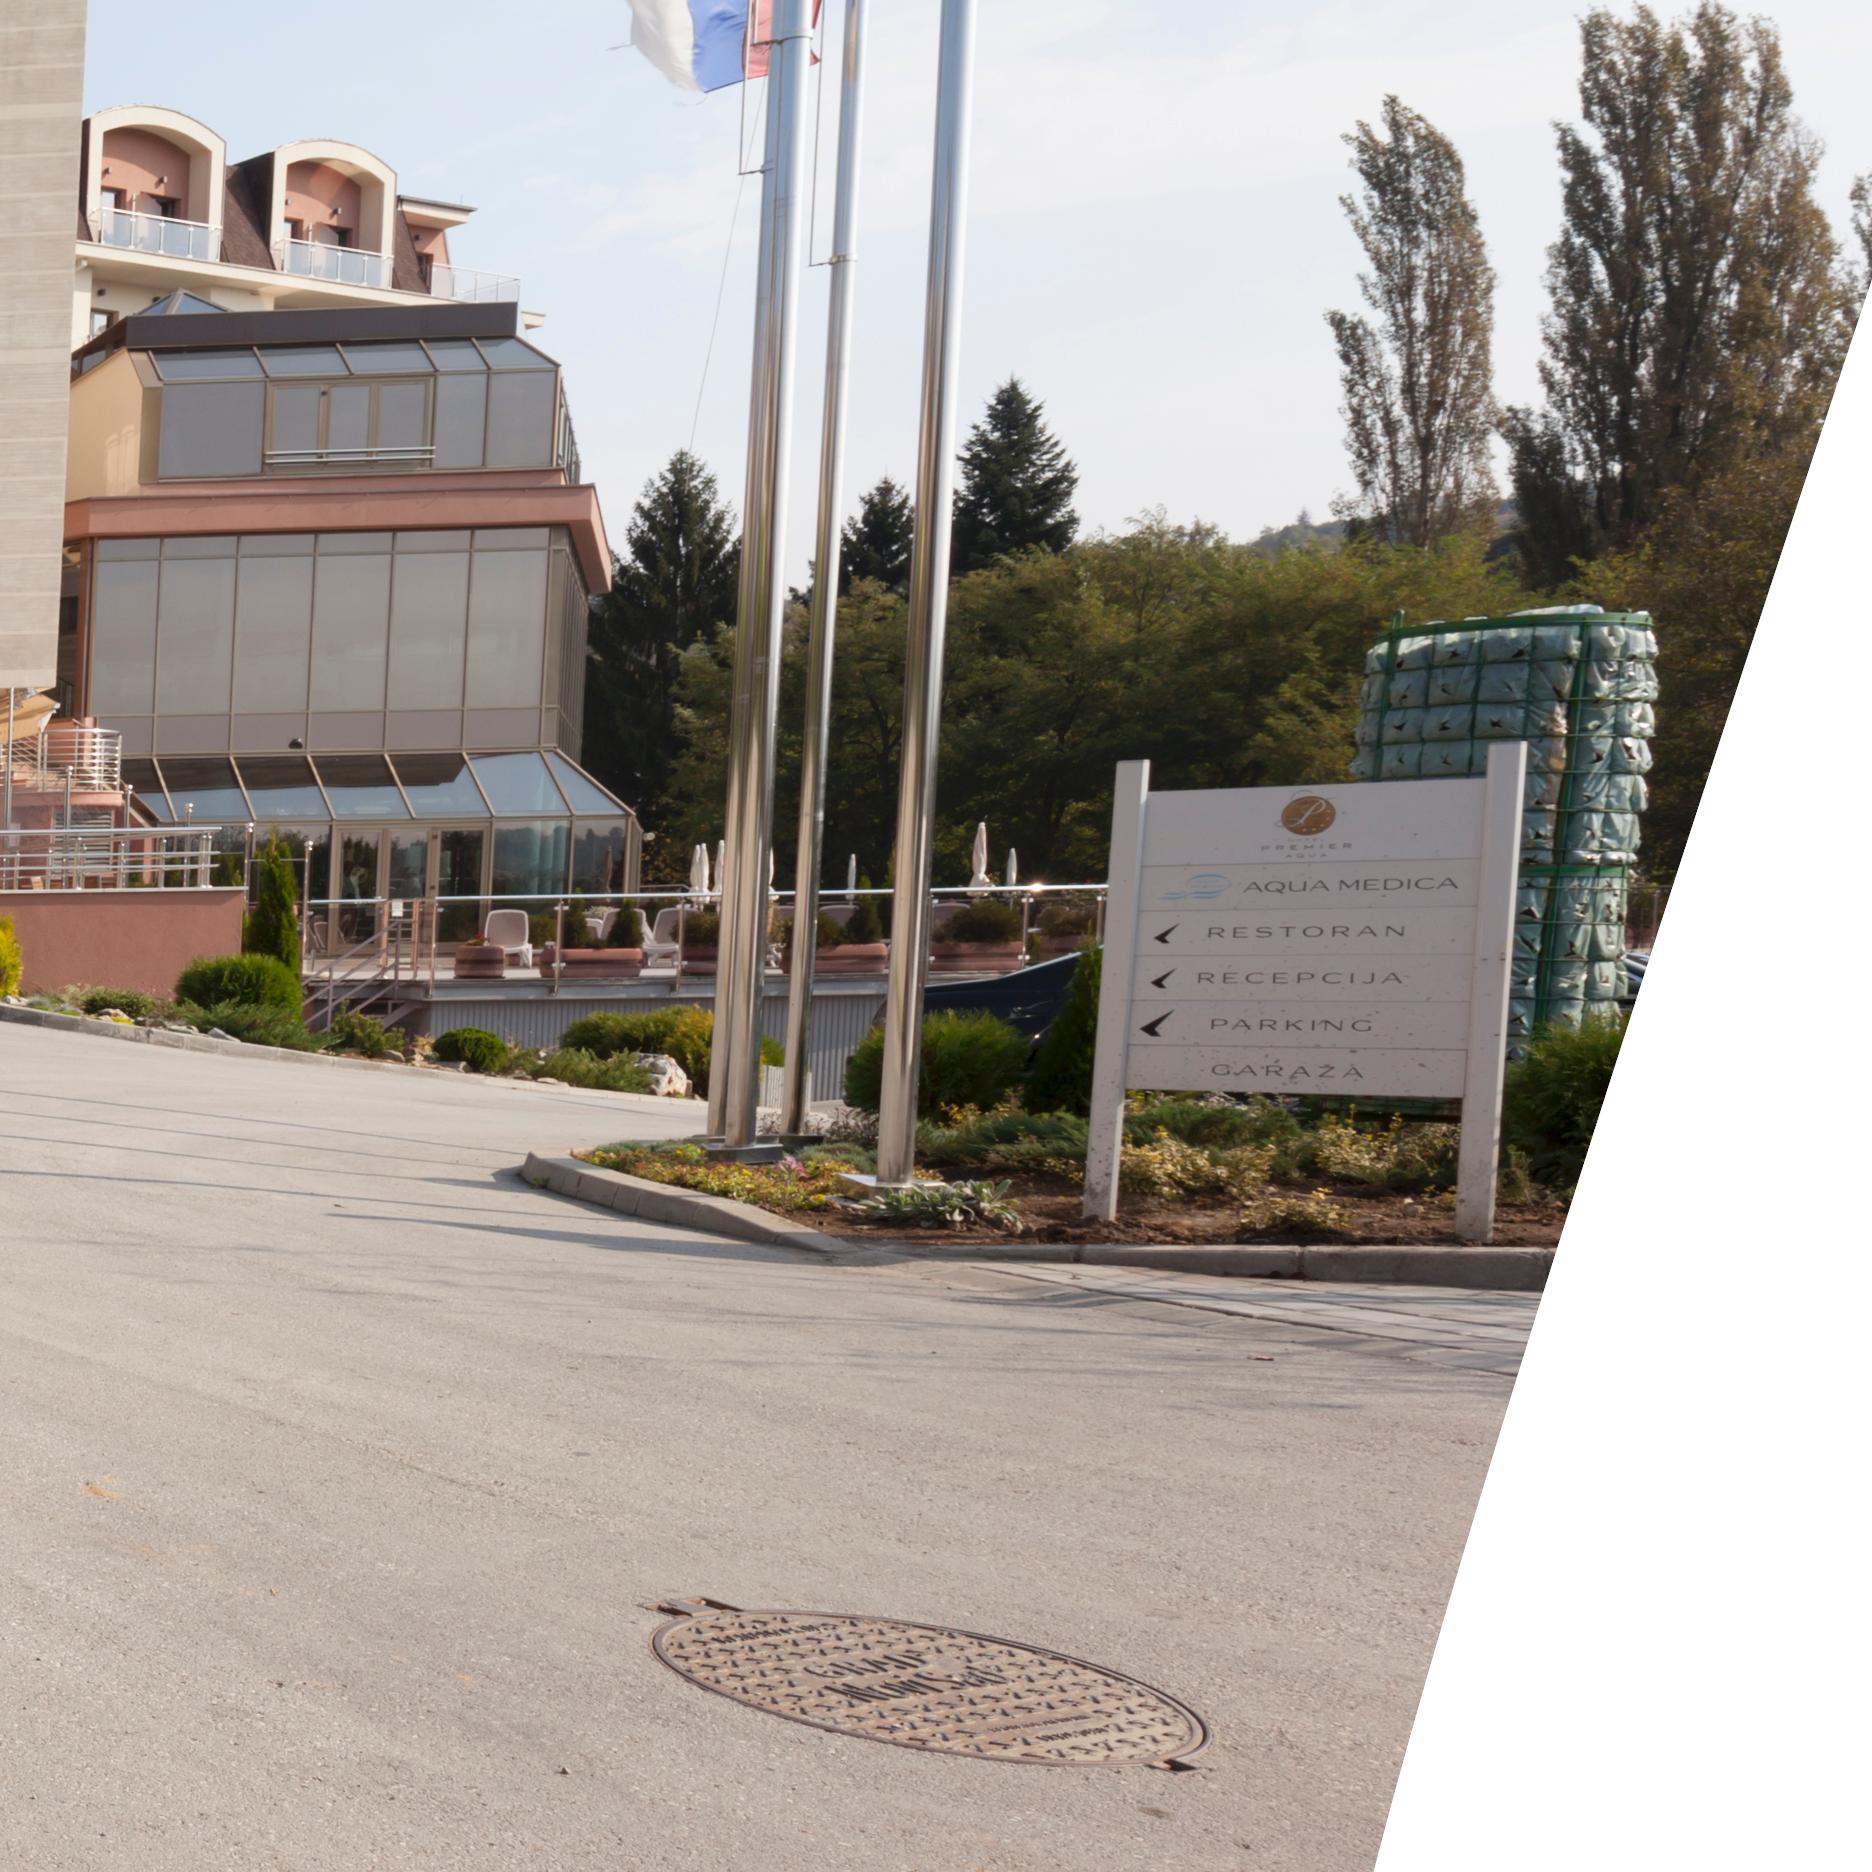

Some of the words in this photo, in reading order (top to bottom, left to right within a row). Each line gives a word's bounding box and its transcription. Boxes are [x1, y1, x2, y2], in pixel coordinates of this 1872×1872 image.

[1260, 842, 1353, 851] PREMIER
[1243, 880, 1330, 894] AQUA
[1338, 877, 1459, 891] MEDICA
[1206, 925, 1406, 939] RESTORAN
[1196, 971, 1404, 985] RECEPCIJA
[1209, 1017, 1373, 1033] PARKING
